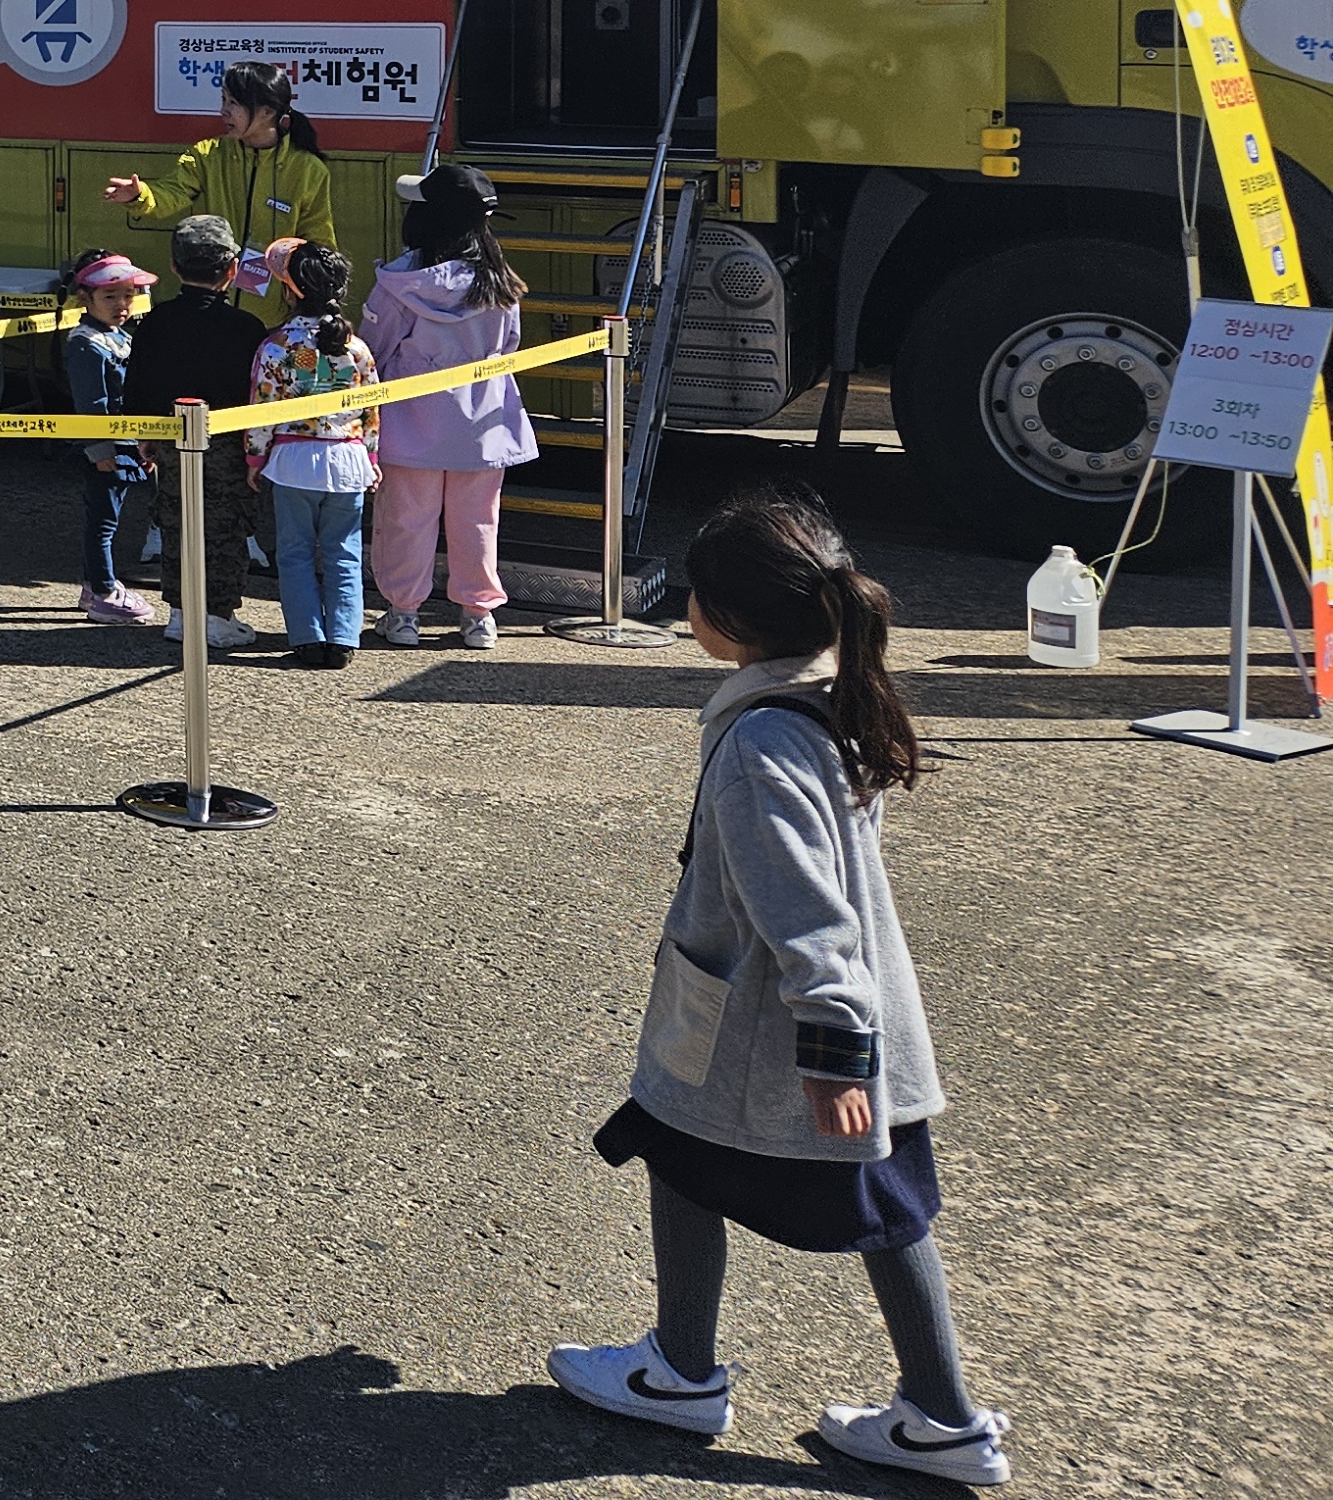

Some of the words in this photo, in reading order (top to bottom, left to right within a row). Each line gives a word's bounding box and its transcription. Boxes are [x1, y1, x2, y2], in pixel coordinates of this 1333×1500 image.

[178, 38, 265, 53] 경상남도교육청
[267, 46, 306, 54] INSTITUTE
[307, 46, 317, 54] OF
[319, 47, 354, 55] STUDENT
[355, 47, 385, 55] SAFETY
[178, 57, 418, 104] 학생체험원
[1224, 318, 1295, 341] 점심시간
[1189, 343, 1239, 360] 12:00
[1249, 351, 1315, 369] ~13:00
[1211, 399, 1261, 420] 3회차
[1168, 420, 1218, 440] 13:00
[1228, 430, 1292, 450] ~13:50
